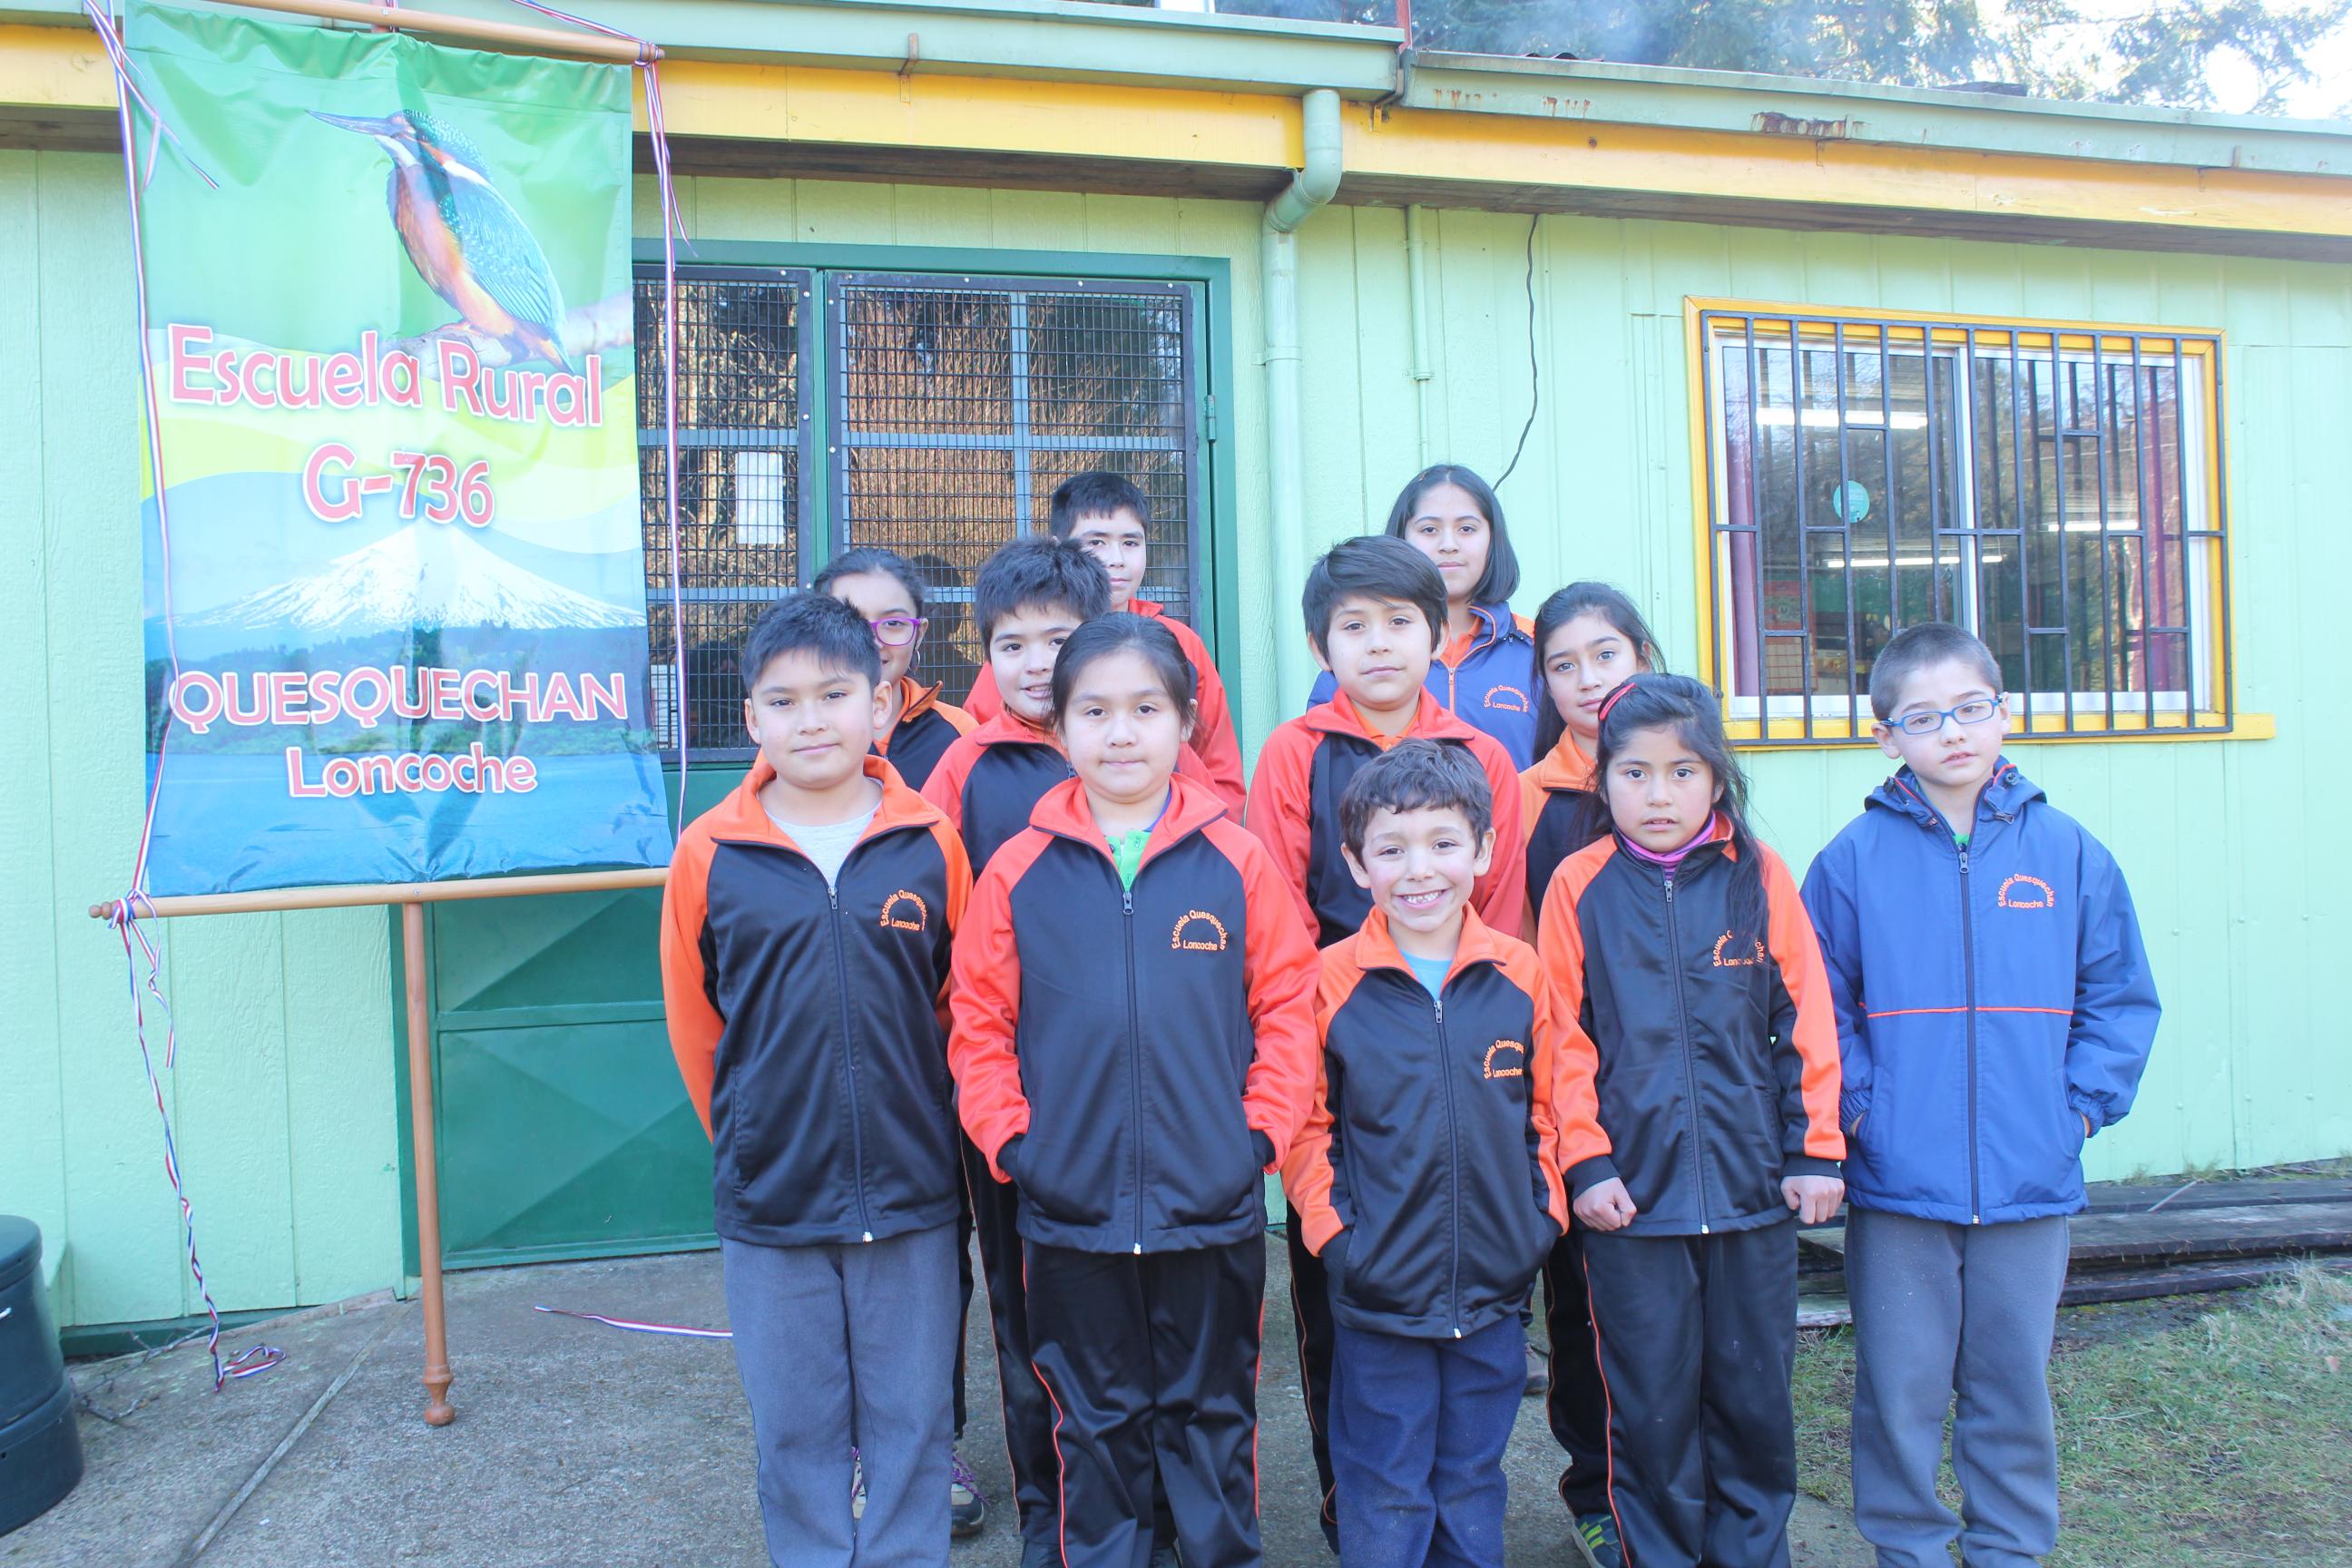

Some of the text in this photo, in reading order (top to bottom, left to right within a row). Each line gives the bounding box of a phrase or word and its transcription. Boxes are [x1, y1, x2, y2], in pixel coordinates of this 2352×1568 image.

[167, 323, 604, 427] Escuela Rural
[303, 444, 495, 528] G-736
[170, 666, 629, 733] QUESQUECHAN
[286, 742, 538, 798] Loncoche
[880, 893, 899, 926] Escuela
[1998, 877, 2014, 907] Escuela
[1171, 909, 1228, 950] Escuela Quesquechan
[1182, 939, 1217, 951] Loncoche
[1713, 935, 1729, 966] Escuela
[1484, 1045, 1496, 1079] Escuela
